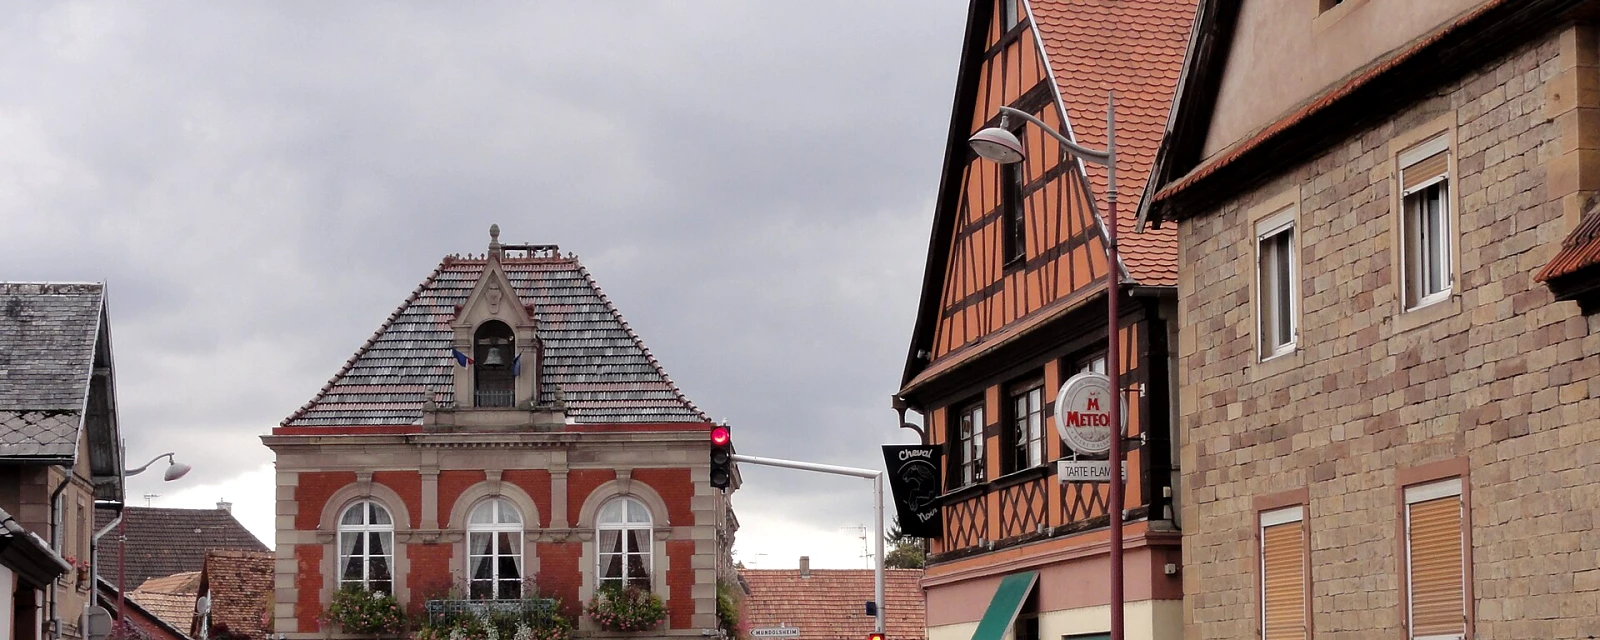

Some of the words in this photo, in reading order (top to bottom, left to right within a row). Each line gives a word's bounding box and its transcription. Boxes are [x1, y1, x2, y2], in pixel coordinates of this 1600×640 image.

[1066, 411, 1110, 427] METEO
[898, 449, 933, 461] Cheval
[1065, 466, 1088, 477] TARTE
[1090, 466, 1125, 477] FLAME
[916, 508, 938, 523] Noir
